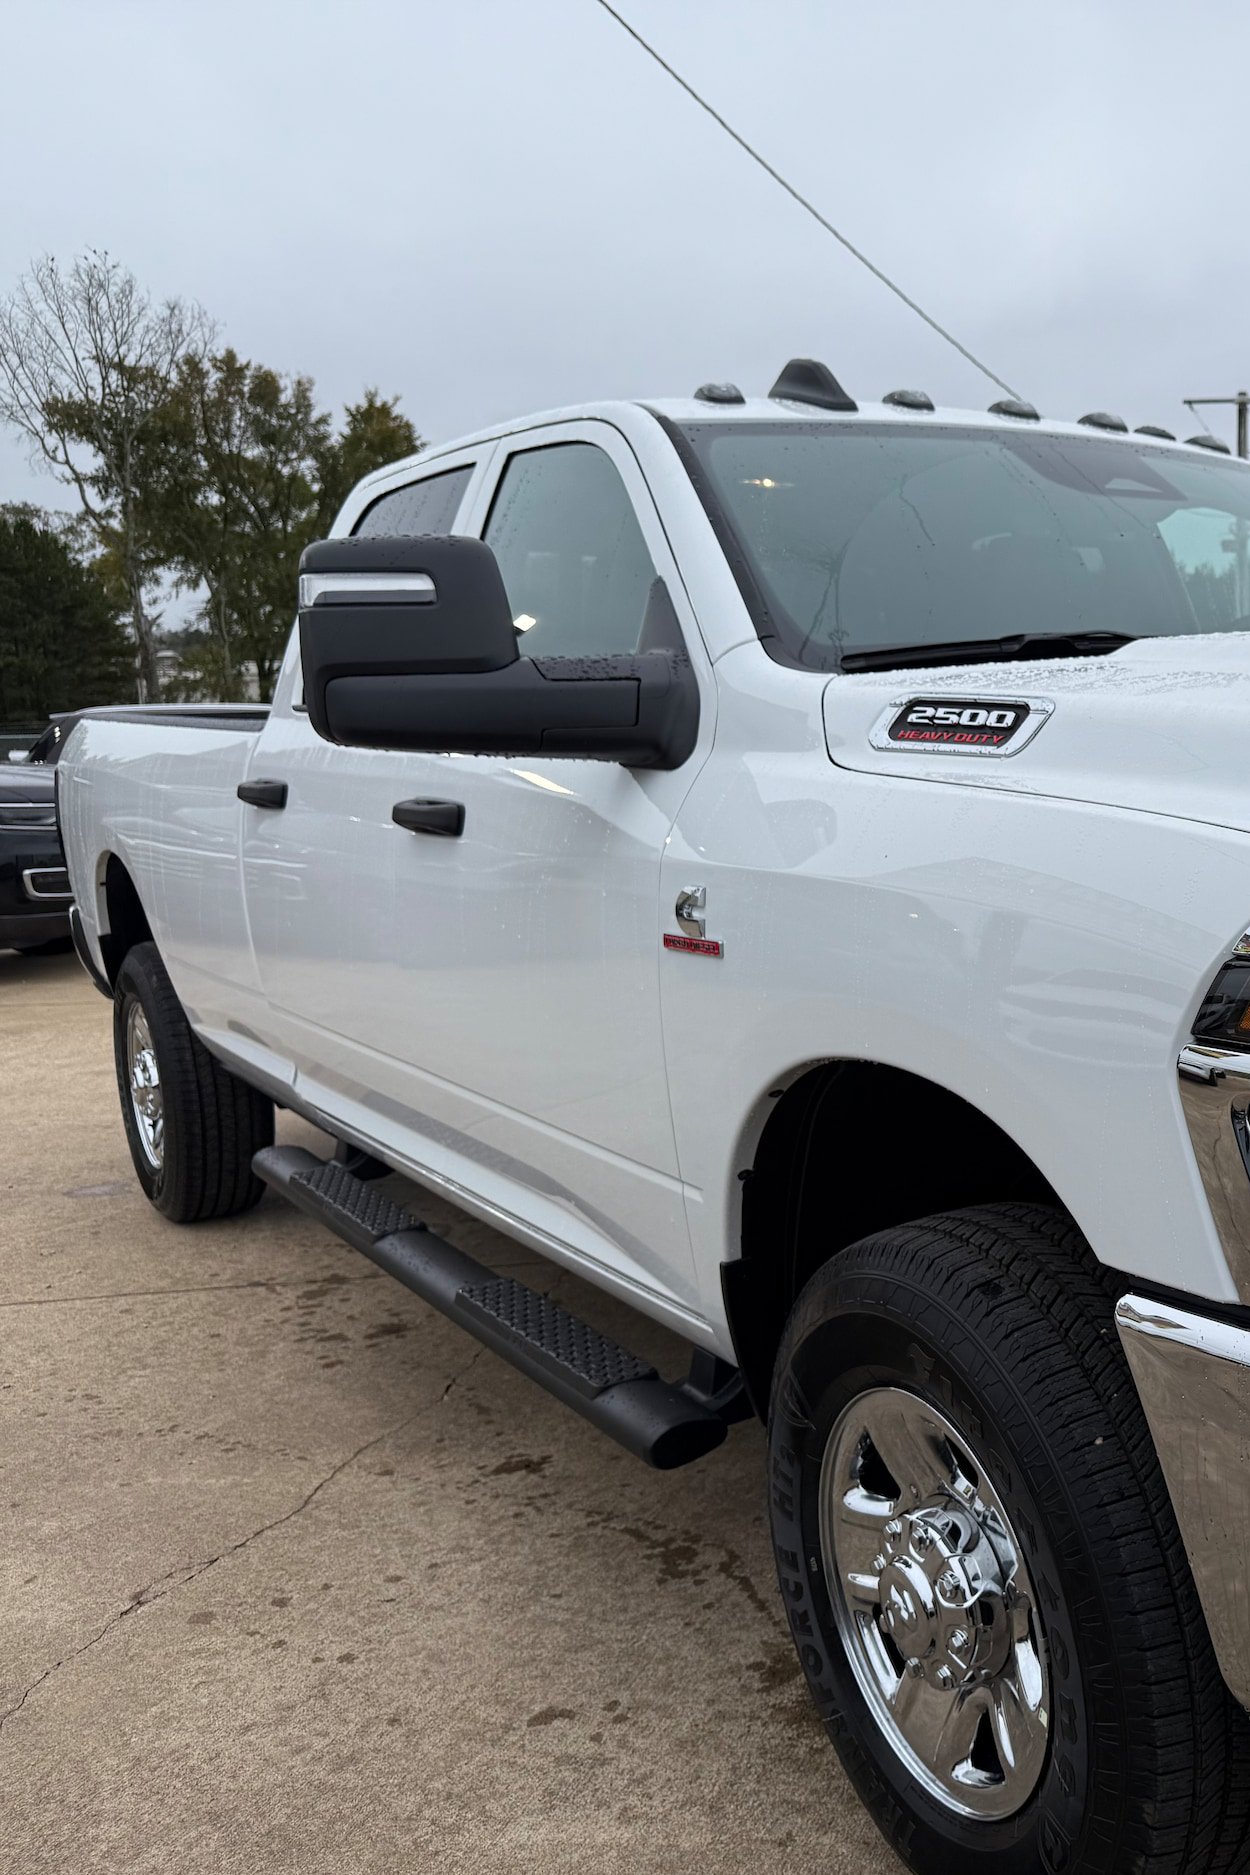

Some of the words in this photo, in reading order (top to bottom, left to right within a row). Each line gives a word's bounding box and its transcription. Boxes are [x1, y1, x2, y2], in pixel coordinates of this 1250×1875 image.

[907, 706, 1017, 728] 2500
[897, 730, 954, 742] HEAVY
[954, 733, 1007, 744] DUTY
